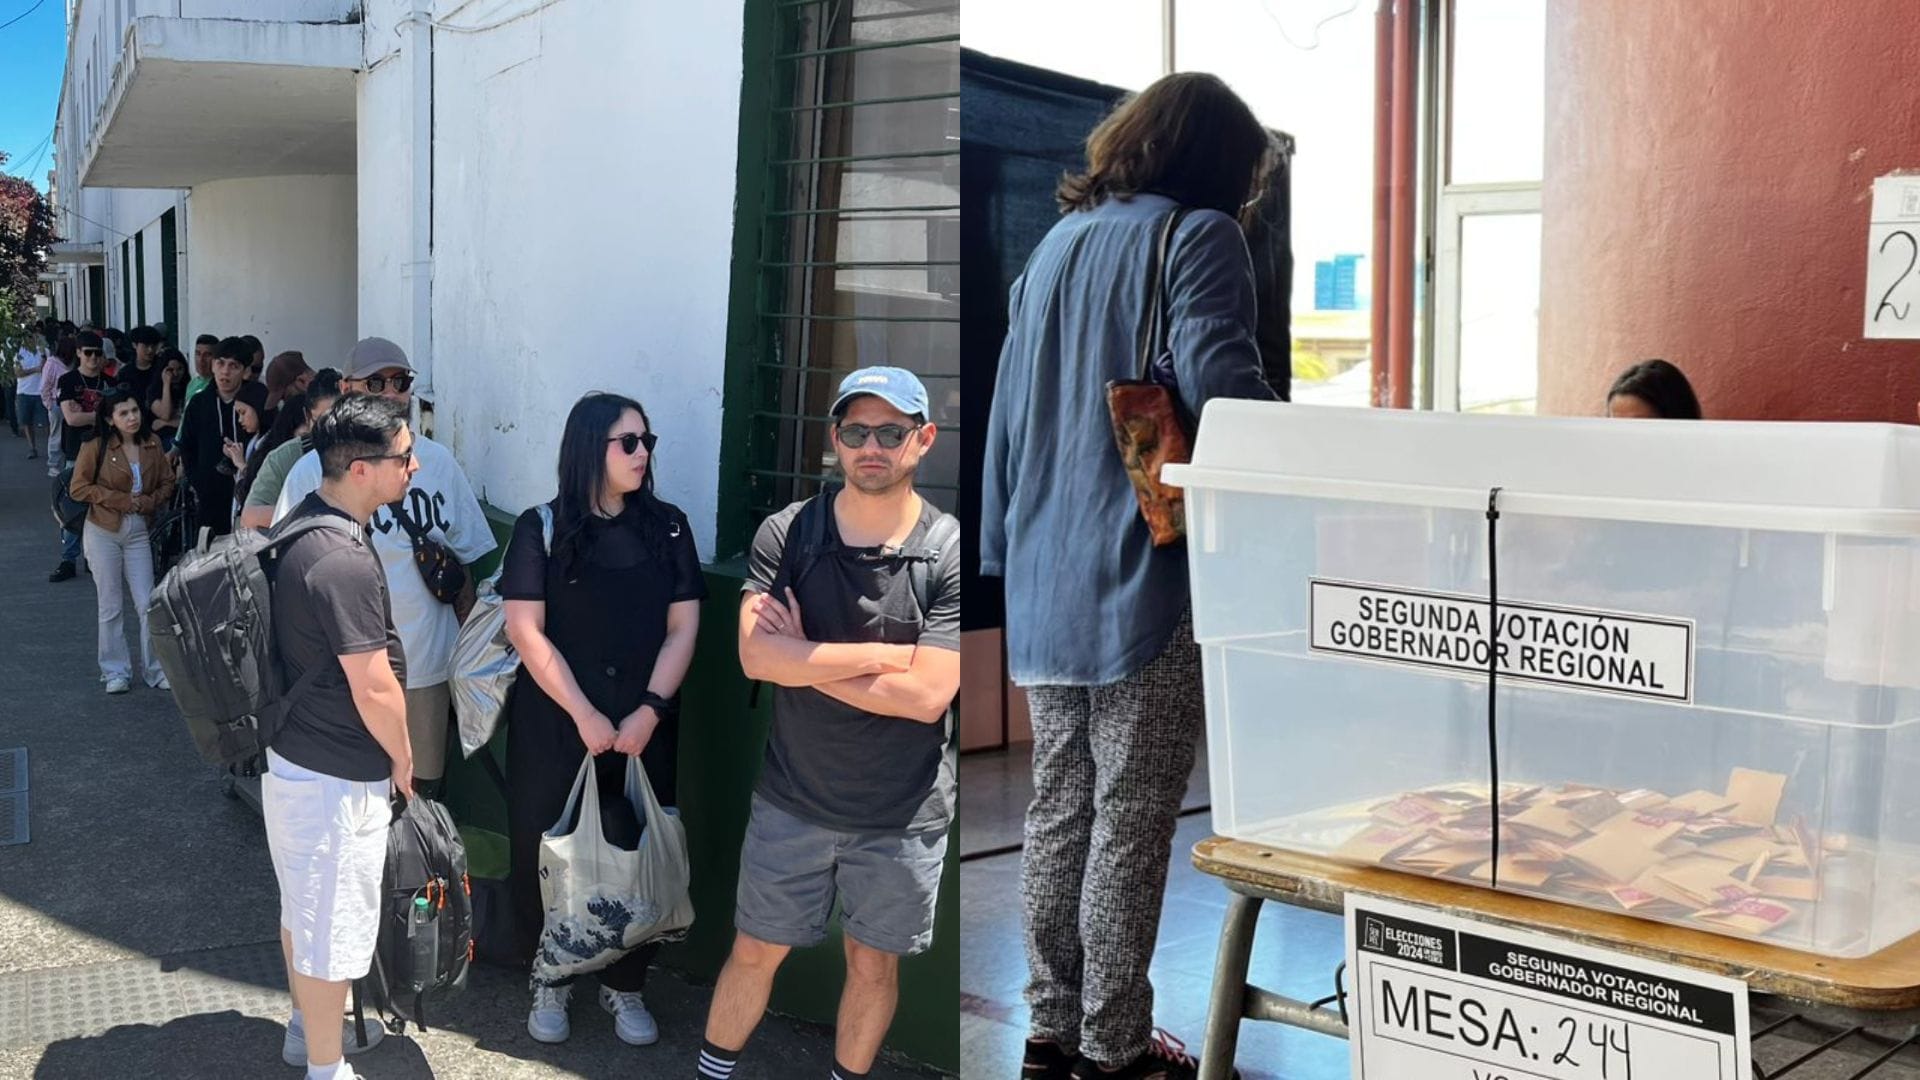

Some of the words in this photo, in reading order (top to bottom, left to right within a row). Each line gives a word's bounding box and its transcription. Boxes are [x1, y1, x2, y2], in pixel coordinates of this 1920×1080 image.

[1874, 230, 1920, 323] 2
[1359, 595, 1481, 635] SEGUNDA
[1331, 620, 1509, 668] GOBERNADOR
[1520, 646, 1664, 689] REGIONAL
[1385, 927, 1442, 950] ELECCIONES
[1397, 943, 1423, 960] 2024
[1489, 962, 1607, 1000] GOBERNADOR
[1612, 990, 1703, 1023] REGIONAL
[1507, 951, 1588, 981] SEGUNDA
[1591, 970, 1680, 1002] VOTACIÓN
[1381, 979, 1539, 1060] MESA:
[1553, 1016, 1631, 1080] 244
